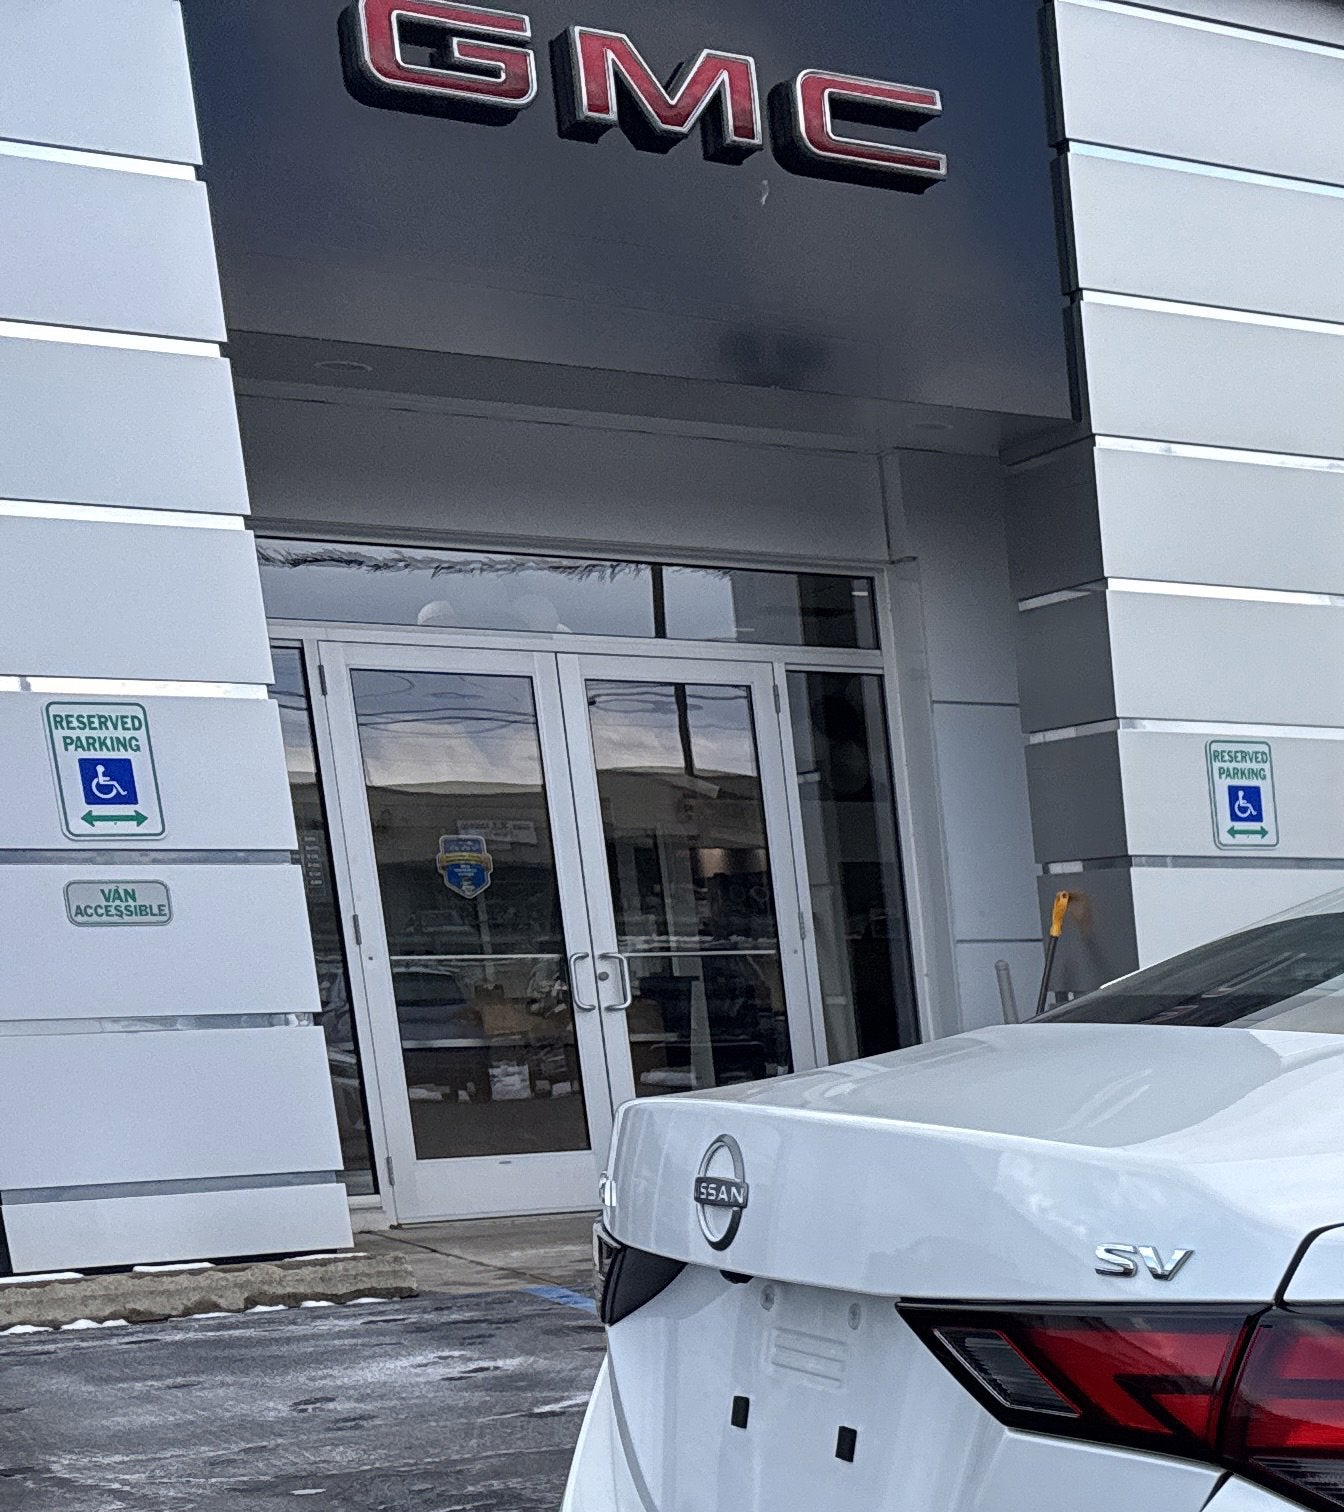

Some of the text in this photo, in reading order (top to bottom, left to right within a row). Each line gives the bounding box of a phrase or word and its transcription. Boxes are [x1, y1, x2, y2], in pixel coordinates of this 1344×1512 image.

[340, 0, 947, 190] GMC
[53, 713, 143, 731] RESERVED
[62, 735, 141, 752] PARKING
[1212, 750, 1268, 764] RESERVED
[1218, 766, 1267, 781] PARKING
[99, 887, 137, 903] VAN
[74, 904, 168, 919] ACCESSIBLE
[1094, 1243, 1195, 1281] SV
